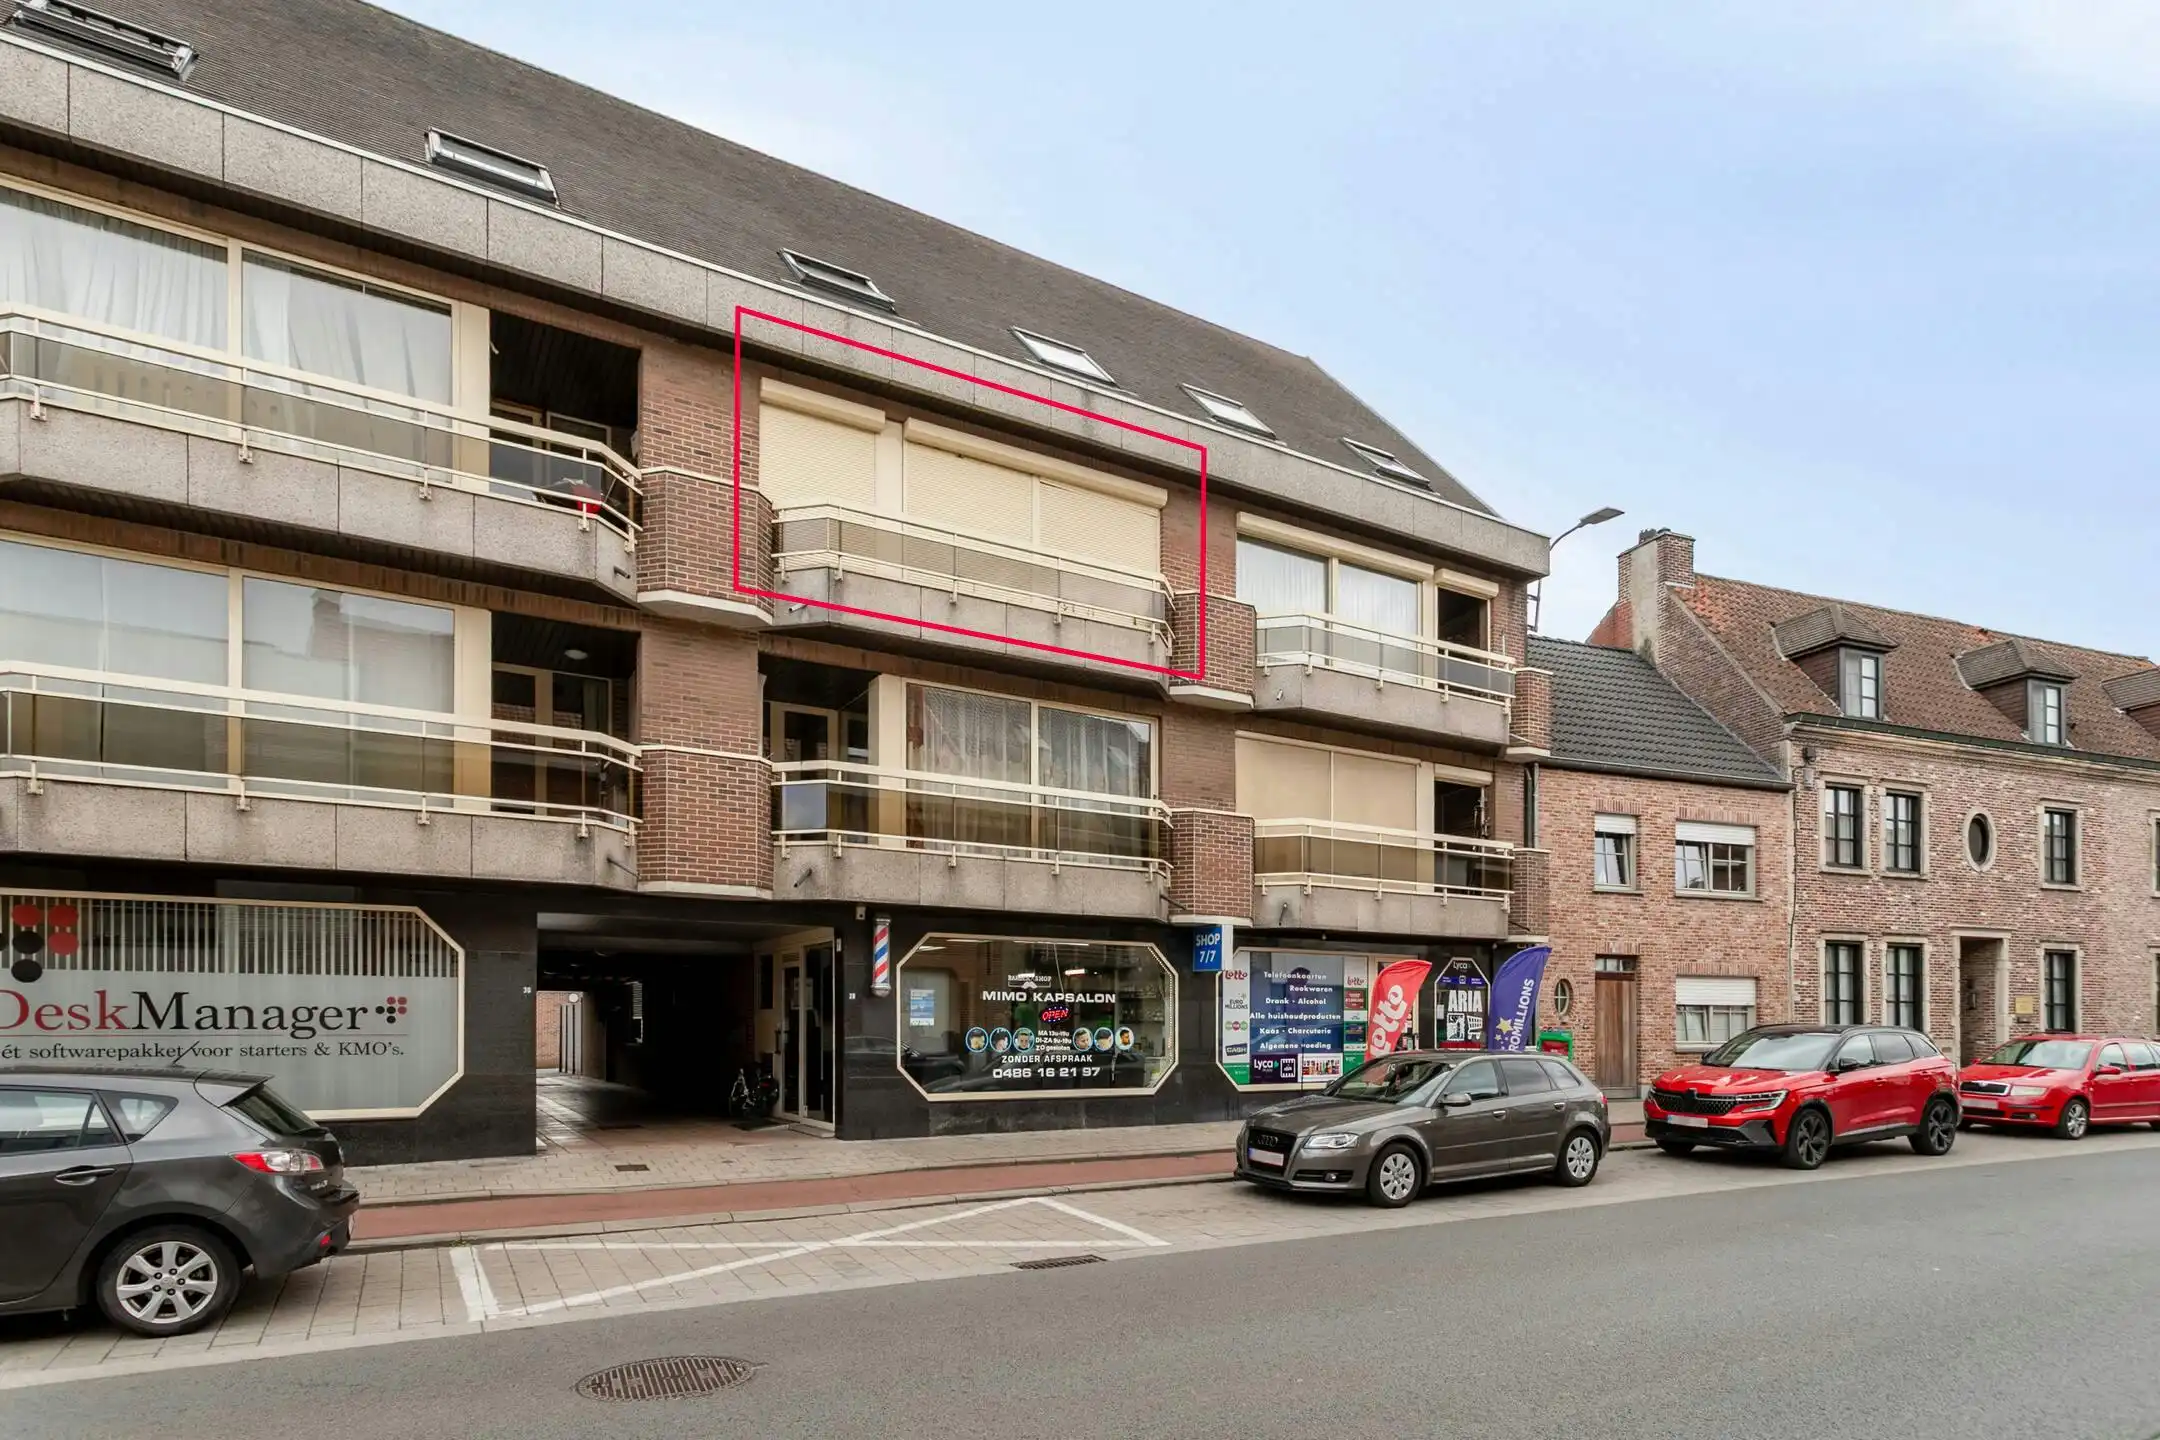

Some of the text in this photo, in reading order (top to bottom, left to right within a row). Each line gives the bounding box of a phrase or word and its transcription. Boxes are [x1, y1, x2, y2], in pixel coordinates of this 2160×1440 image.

[1195, 932, 1221, 946] SHOP
[1199, 949, 1217, 964] 7/7
[982, 990, 1117, 1003] MIMO KAPSALON
[1447, 989, 1483, 1013] ARIA
[1042, 1010, 1068, 1020] OPEN
[1249, 1012, 1266, 1020] Alle
[0, 1043, 23, 1060] ét
[29, 1043, 184, 1061] softwarepakket
[192, 1046, 234, 1058] voor
[240, 1044, 308, 1057] starters
[314, 1042, 331, 1056] &
[1001, 1054, 1093, 1063] ZONDER AFSPRAAK
[1253, 1058, 1274, 1071] Lyca
[992, 1066, 1100, 1078] 0486 16 21 97
